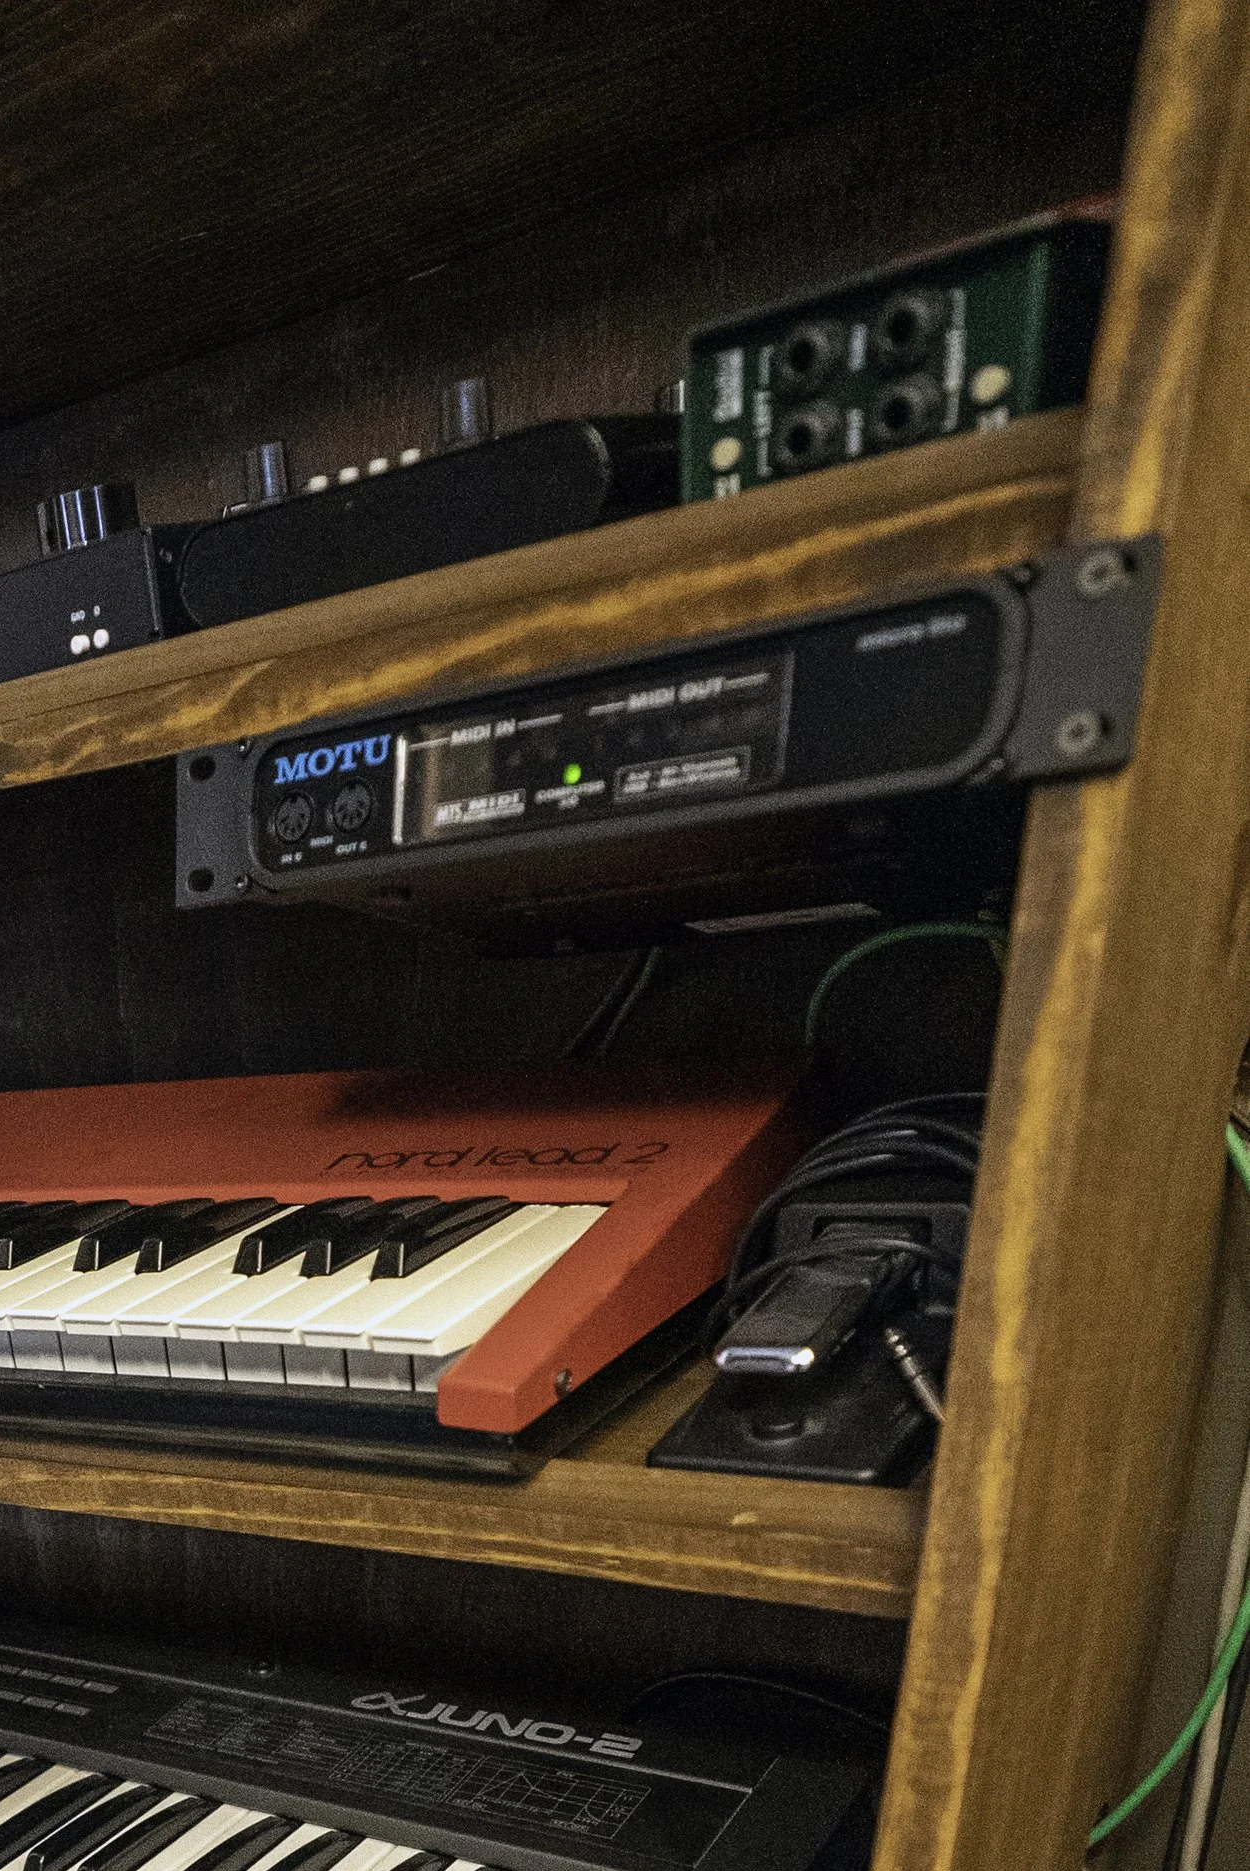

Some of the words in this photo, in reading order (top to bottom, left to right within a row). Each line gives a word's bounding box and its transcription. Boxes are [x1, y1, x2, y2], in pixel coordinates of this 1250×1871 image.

[626, 686, 676, 713] MIDI
[678, 677, 726, 702] OUT
[449, 723, 492, 746] MIDI
[494, 718, 517, 737] IN
[273, 733, 392, 785] MOTU
[323, 1145, 475, 1170] nord
[474, 1141, 623, 1169] lead
[624, 1141, 670, 1165] 2
